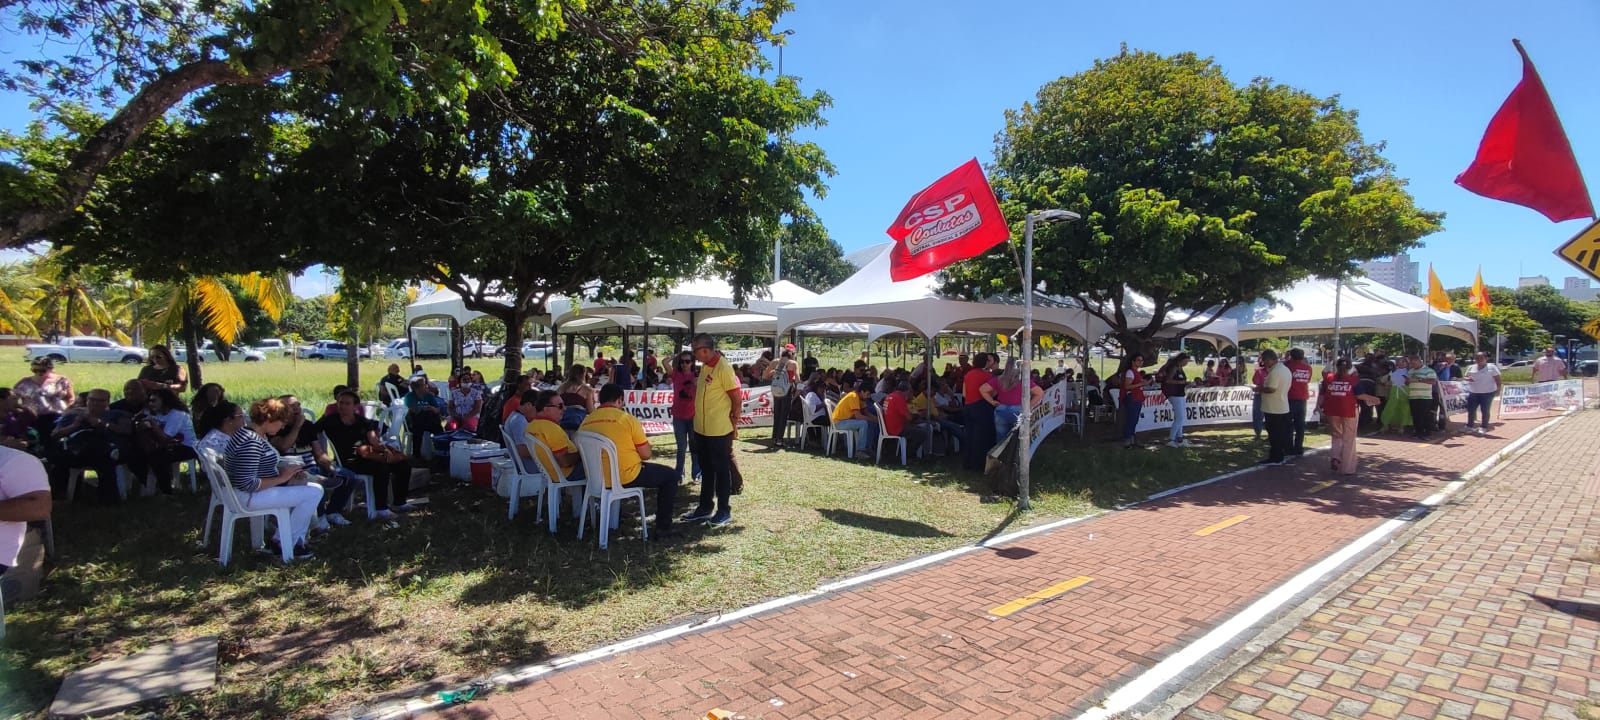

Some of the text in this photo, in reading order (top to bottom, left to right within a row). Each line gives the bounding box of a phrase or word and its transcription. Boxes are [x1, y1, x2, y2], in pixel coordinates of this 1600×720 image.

[904, 193, 966, 229] CSP
[911, 210, 974, 245] Conlutas
[911, 243, 931, 254] CENTRAL
[650, 391, 666, 404] LEI
[1196, 390, 1218, 402] FALTA
[1220, 390, 1231, 401] DE
[1231, 389, 1254, 400] DINHE
[1186, 406, 1198, 420] DE
[1200, 404, 1241, 419] RESPEITO
